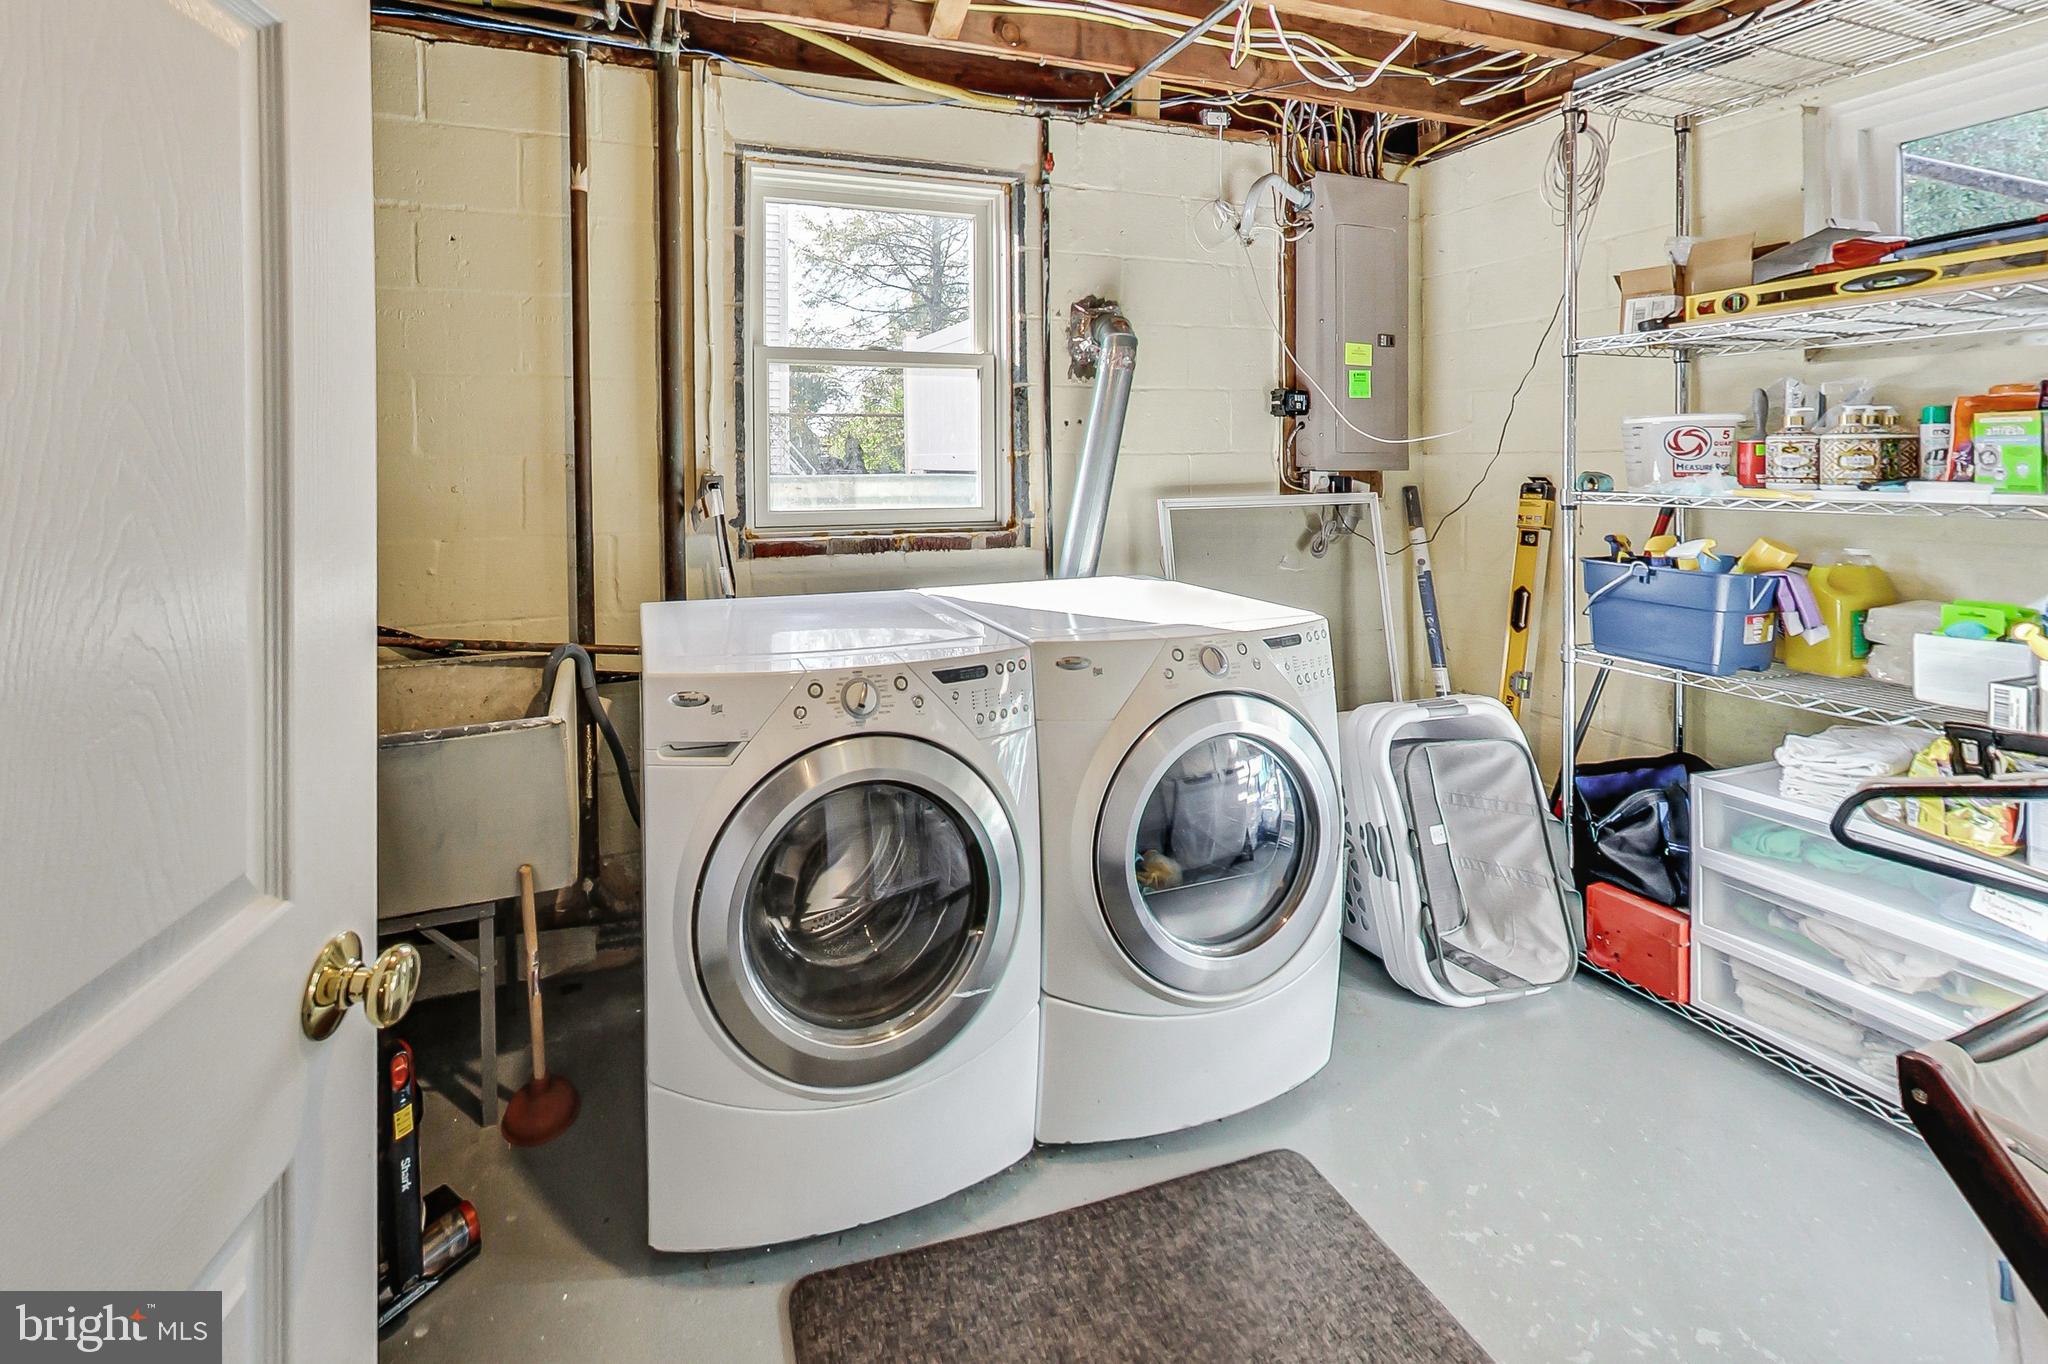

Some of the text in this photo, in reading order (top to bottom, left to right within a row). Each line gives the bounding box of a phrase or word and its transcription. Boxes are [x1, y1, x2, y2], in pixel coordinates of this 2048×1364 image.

[1722, 430, 1730, 439] 5
[1676, 463, 1713, 471] MEASURE
[401, 1157, 412, 1193] Shark
